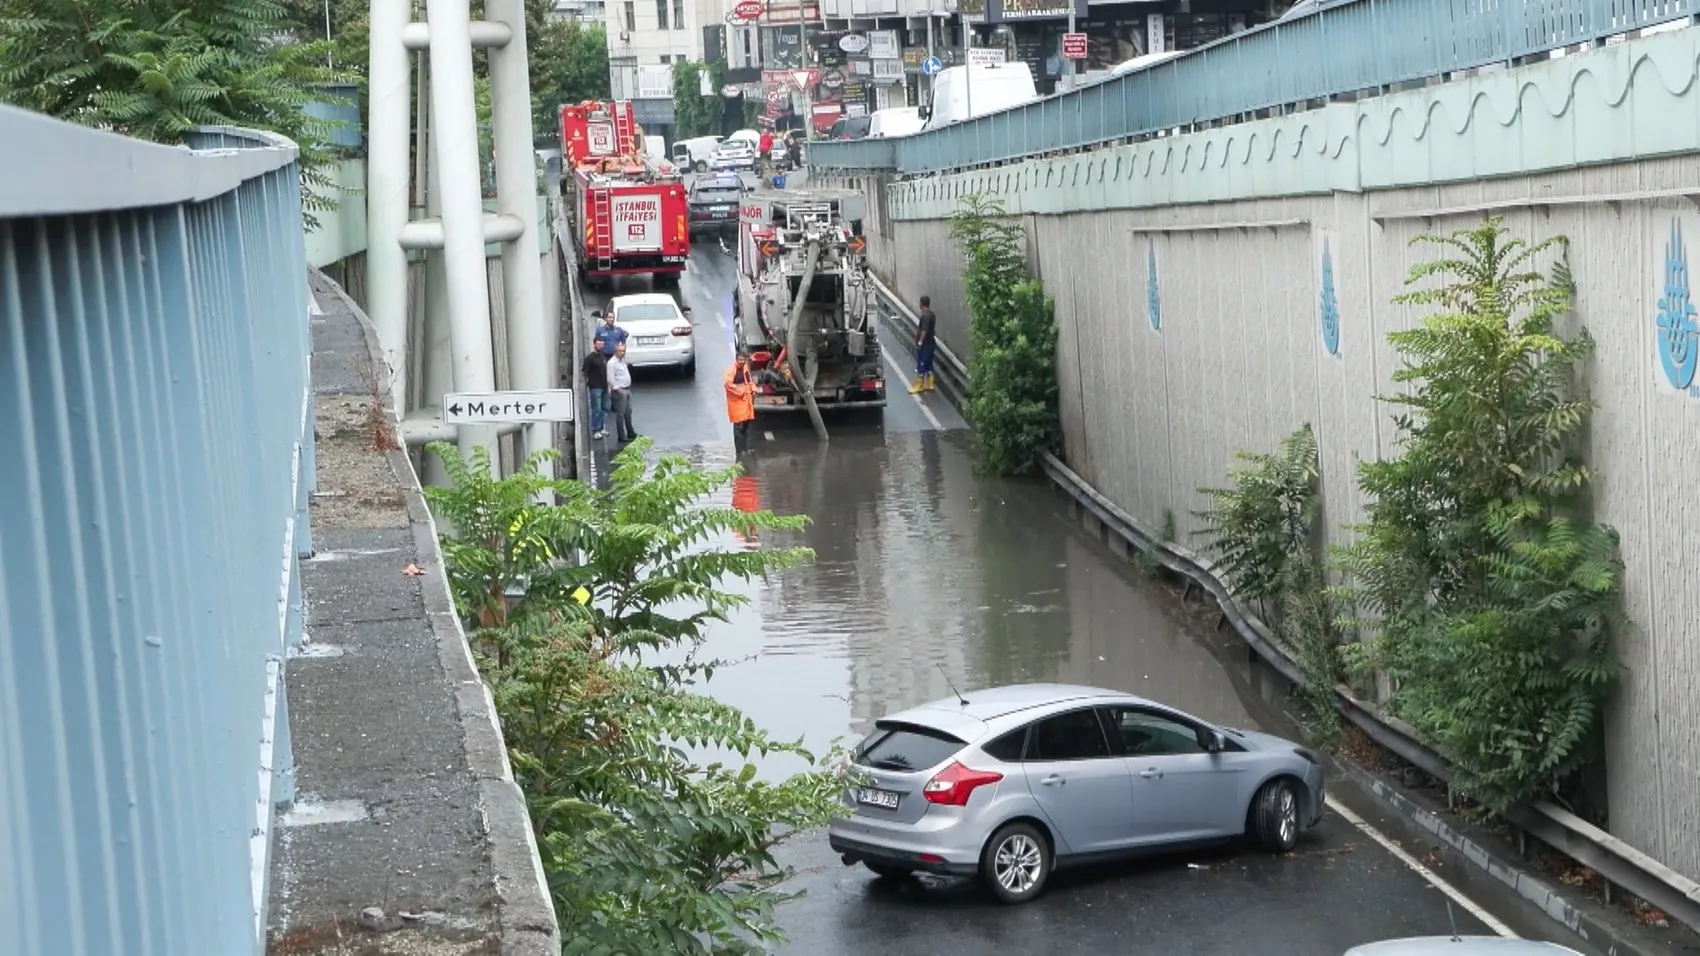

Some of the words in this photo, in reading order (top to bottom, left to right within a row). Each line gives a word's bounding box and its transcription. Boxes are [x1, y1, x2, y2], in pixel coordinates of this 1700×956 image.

[615, 200, 657, 212] İSTANBUL
[615, 211, 657, 222] İTFAİYESİ
[630, 225, 644, 234] 112
[468, 401, 547, 416] Merter
